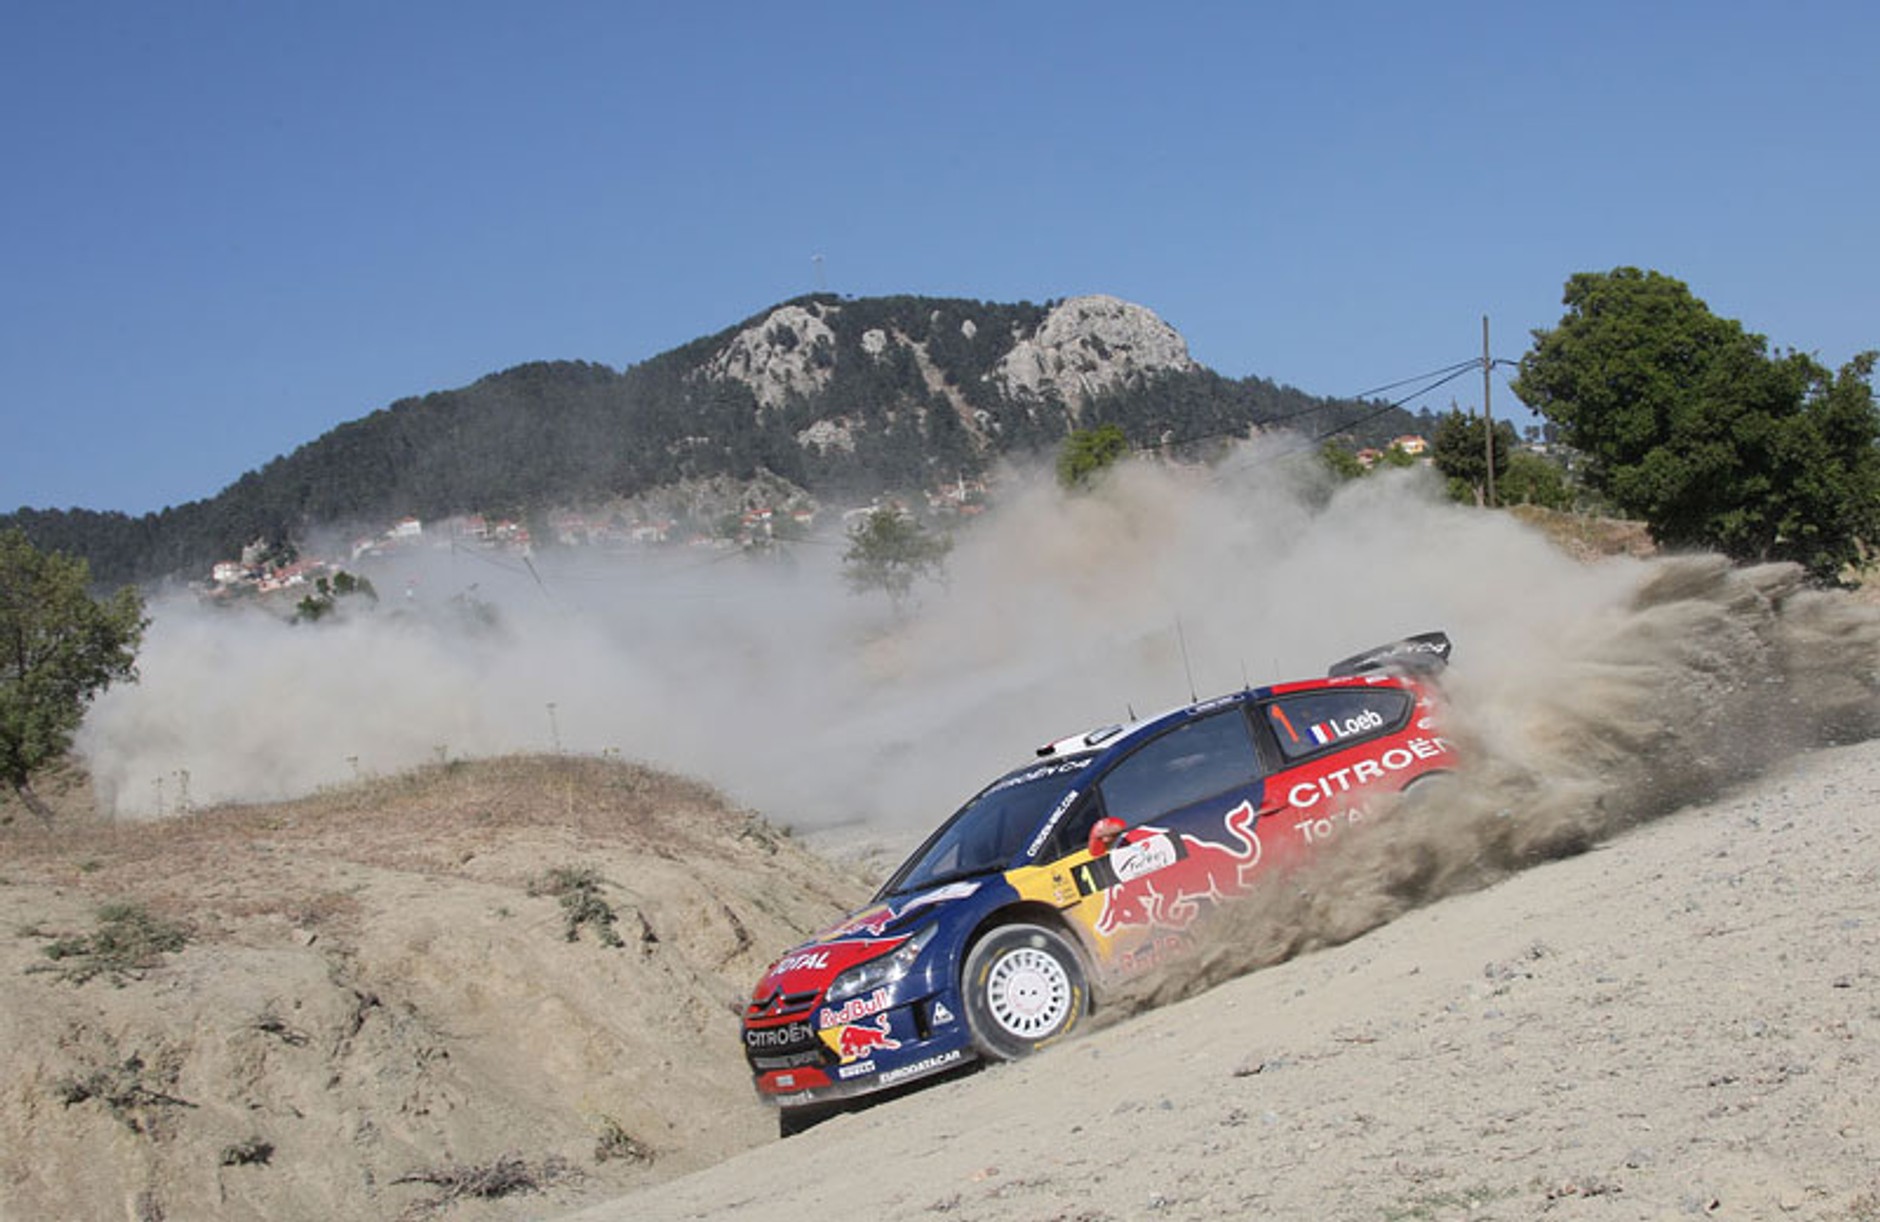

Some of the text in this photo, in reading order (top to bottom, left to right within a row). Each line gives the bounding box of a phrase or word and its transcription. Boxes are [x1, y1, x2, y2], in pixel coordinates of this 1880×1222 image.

[1271, 703, 1299, 742] 1
[1330, 709, 1383, 738] Loeb
[1081, 864, 1097, 893] 1
[769, 951, 831, 977] TOTAL
[746, 1021, 815, 1048] CITROËN
